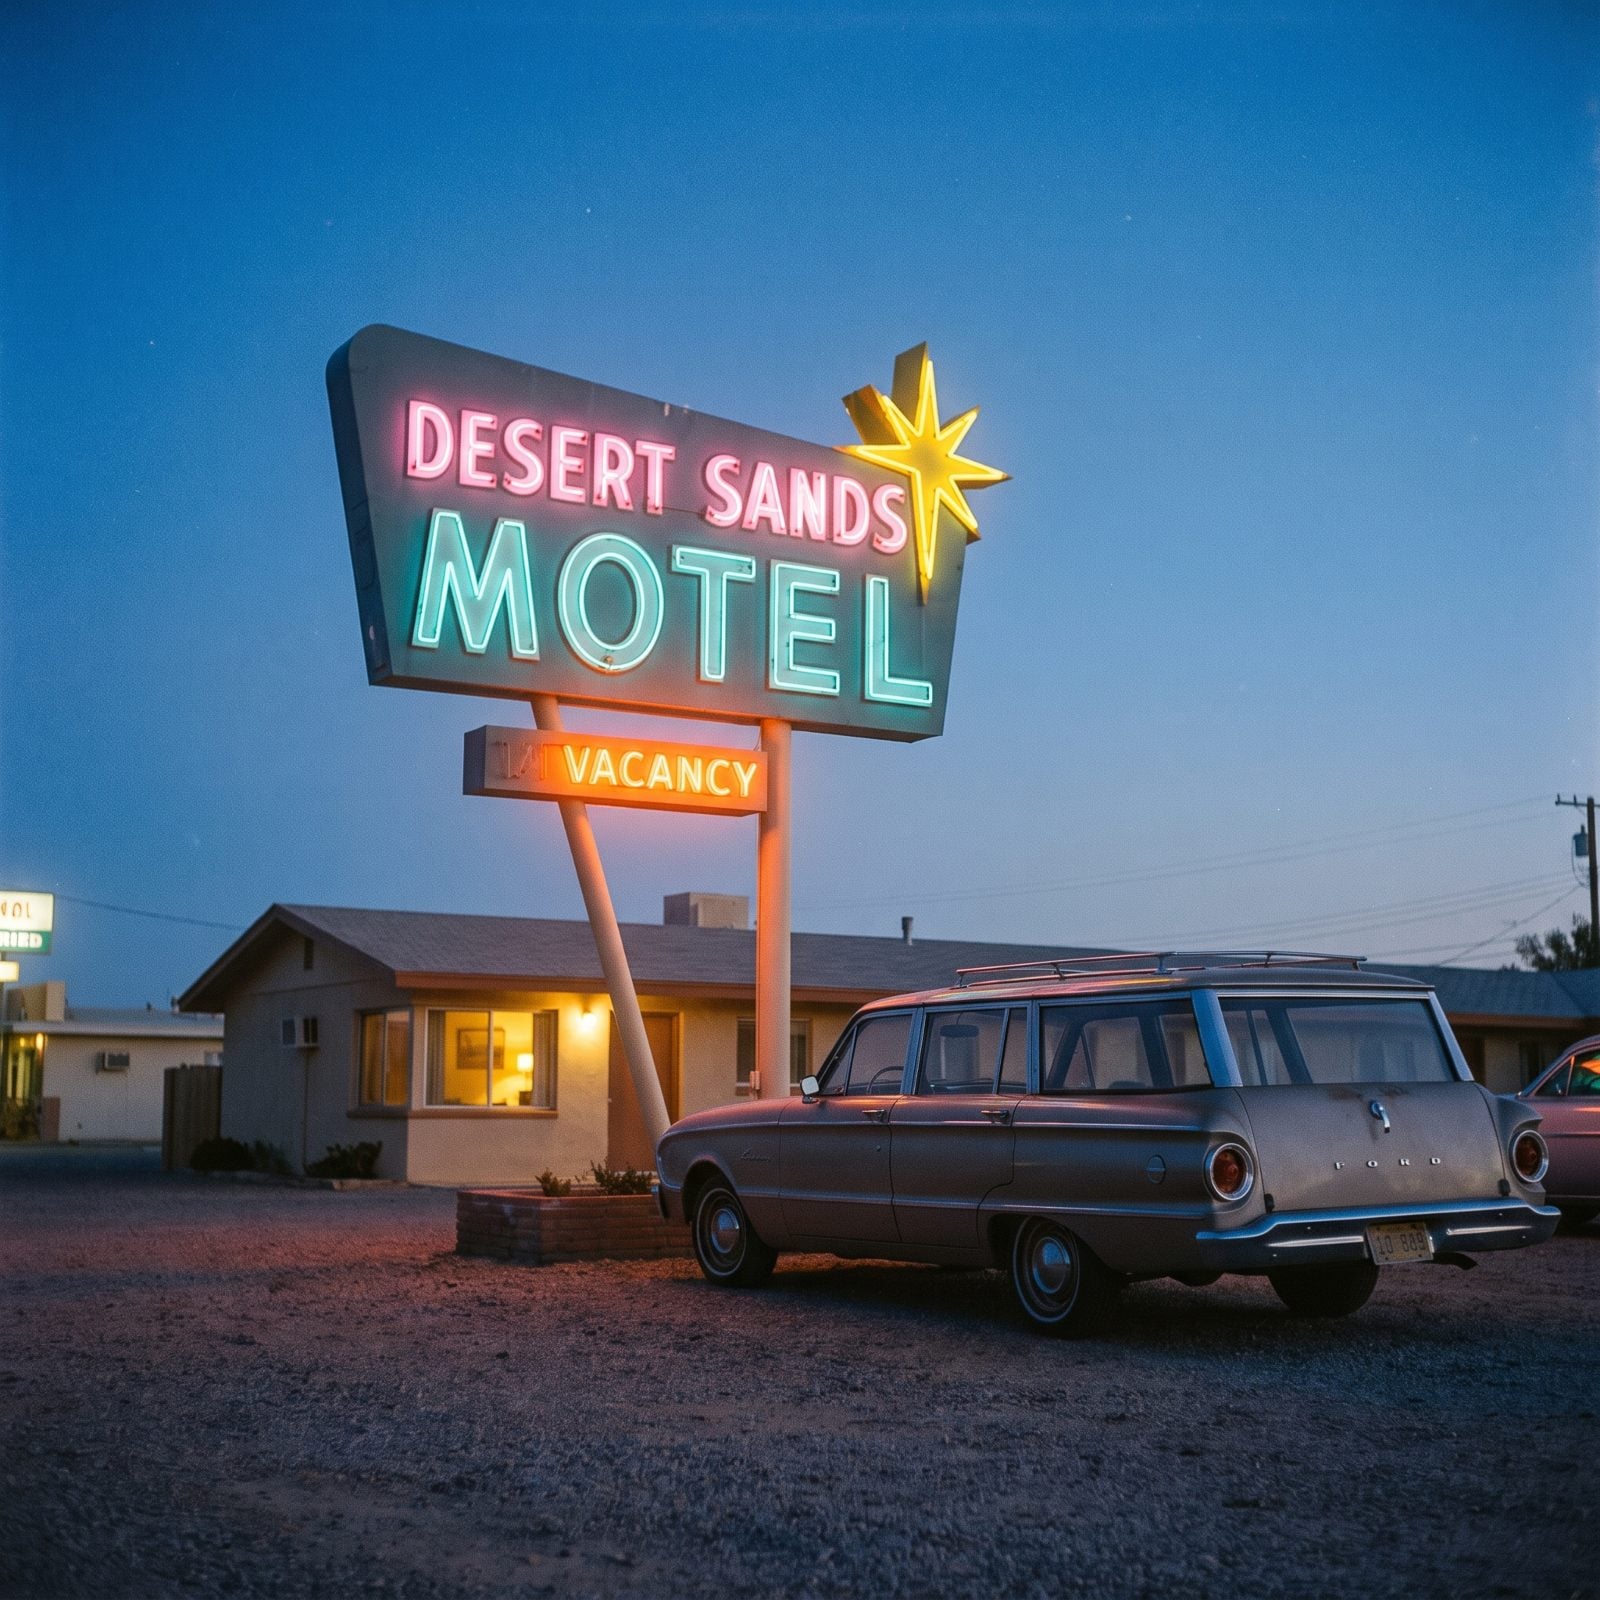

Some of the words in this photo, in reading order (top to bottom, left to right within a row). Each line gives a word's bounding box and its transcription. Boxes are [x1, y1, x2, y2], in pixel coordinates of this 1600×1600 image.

[407, 399, 676, 515] DESERT
[705, 453, 908, 554] SANDS
[411, 507, 934, 707] MOTEL
[563, 744, 758, 798] VACANCY
[1334, 1157, 1441, 1170] FORD
